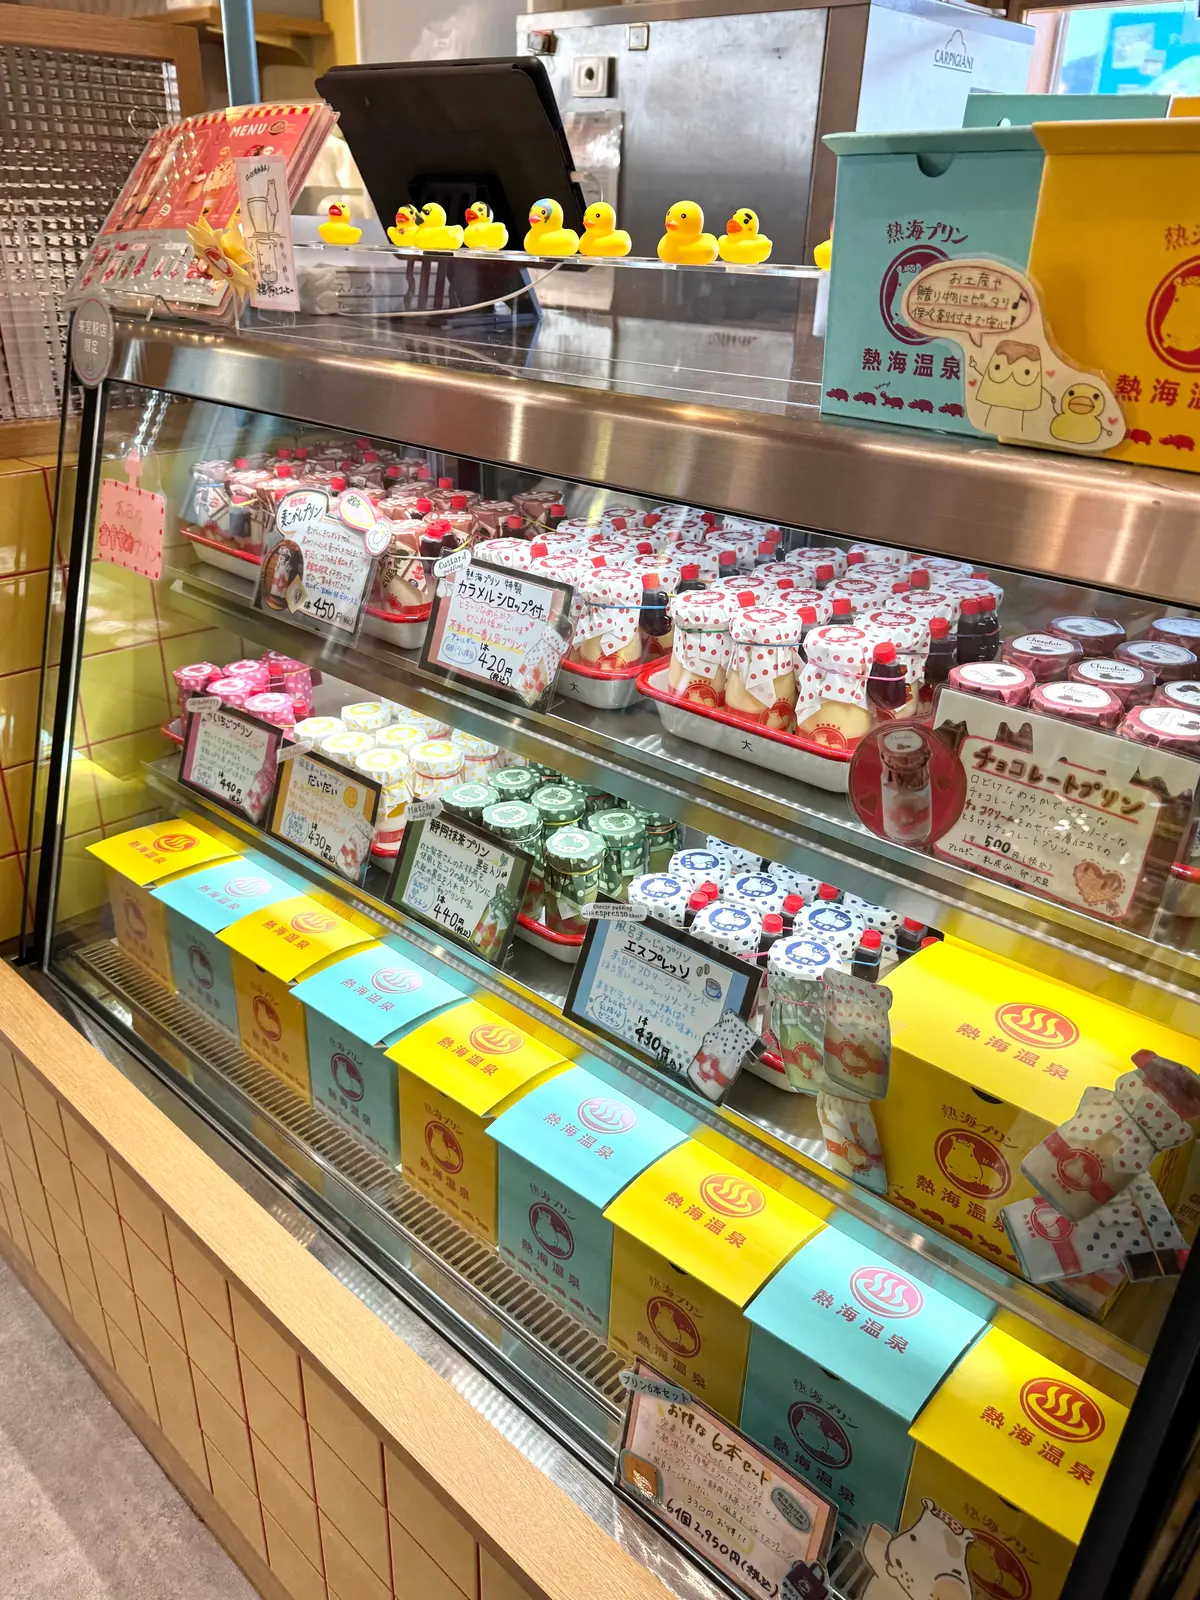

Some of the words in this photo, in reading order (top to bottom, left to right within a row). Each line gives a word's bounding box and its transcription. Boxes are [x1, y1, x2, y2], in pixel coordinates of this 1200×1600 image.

[934, 49, 974, 69] CARPIGIANI
[229, 122, 267, 138] MENU
[886, 219, 970, 245] 熱海プリン
[949, 271, 1002, 290] お土産や
[861, 347, 961, 381] 熱海温泉
[438, 551, 468, 570] Custard
[443, 563, 464, 575] pudding
[466, 569, 500, 587] 熱海プリン
[504, 579, 523, 596] 特製
[480, 643, 490, 652] 1本
[1026, 636, 1063, 647] Chocolate
[478, 652, 513, 678] 420円
[1090, 662, 1131, 673] Chocolate
[569, 681, 580, 694] 大
[1062, 684, 1100, 700] Chocolate
[741, 739, 754, 753] 大
[308, 774, 338, 796] だいだい
[973, 744, 1146, 815] チョコレートプリン
[408, 802, 436, 815] Matcha
[308, 830, 332, 854] 430円
[429, 818, 490, 858] 静岡抹茶プリン
[475, 858, 502, 878] 黒豆入り
[433, 903, 465, 927] 440円
[594, 909, 629, 919] espresso
[262, 919, 310, 951] 熱海温泉
[623, 939, 690, 979] エスプレッソ
[340, 977, 396, 1013] 熱海温泉
[597, 1011, 620, 1028] ゼラチン
[637, 1015, 648, 1026] 1本
[436, 1036, 499, 1077] 熱海温泉
[635, 1027, 670, 1061] 430円
[955, 1022, 1071, 1081] 熱海温泉
[542, 1112, 615, 1161] 熱海温泉
[940, 1103, 1020, 1150] 熱海プリン
[663, 1190, 748, 1250] 熱海温泉
[521, 1237, 581, 1291] 熱海温泉
[812, 1287, 909, 1355] 熱海温泉
[636, 1330, 707, 1391] 熱海温泉
[623, 1374, 690, 1402] プリン6本セット
[792, 1377, 859, 1430] 熱海プリン
[979, 1404, 1097, 1487] 熱海温泉
[772, 1435, 856, 1507] 熱海温泉
[963, 1502, 1042, 1566] 熱海プリン
